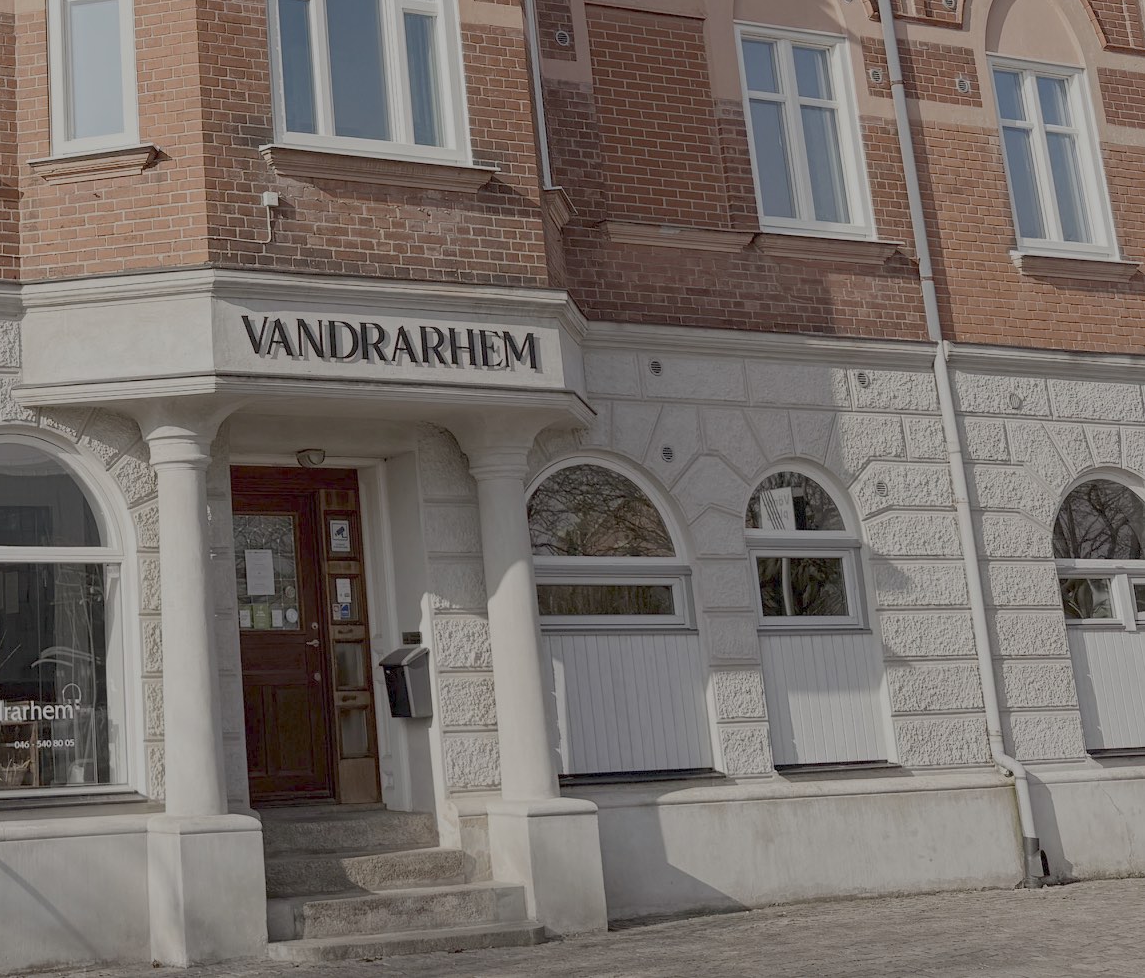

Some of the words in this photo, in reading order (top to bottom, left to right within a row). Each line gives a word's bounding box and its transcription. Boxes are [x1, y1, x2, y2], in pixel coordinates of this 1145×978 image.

[240, 314, 538, 370] VANDRARHEM
[14, 739, 30, 749] 046
[36, 739, 52, 749] 540
[52, 739, 64, 748] 80
[64, 738, 75, 748] 05
